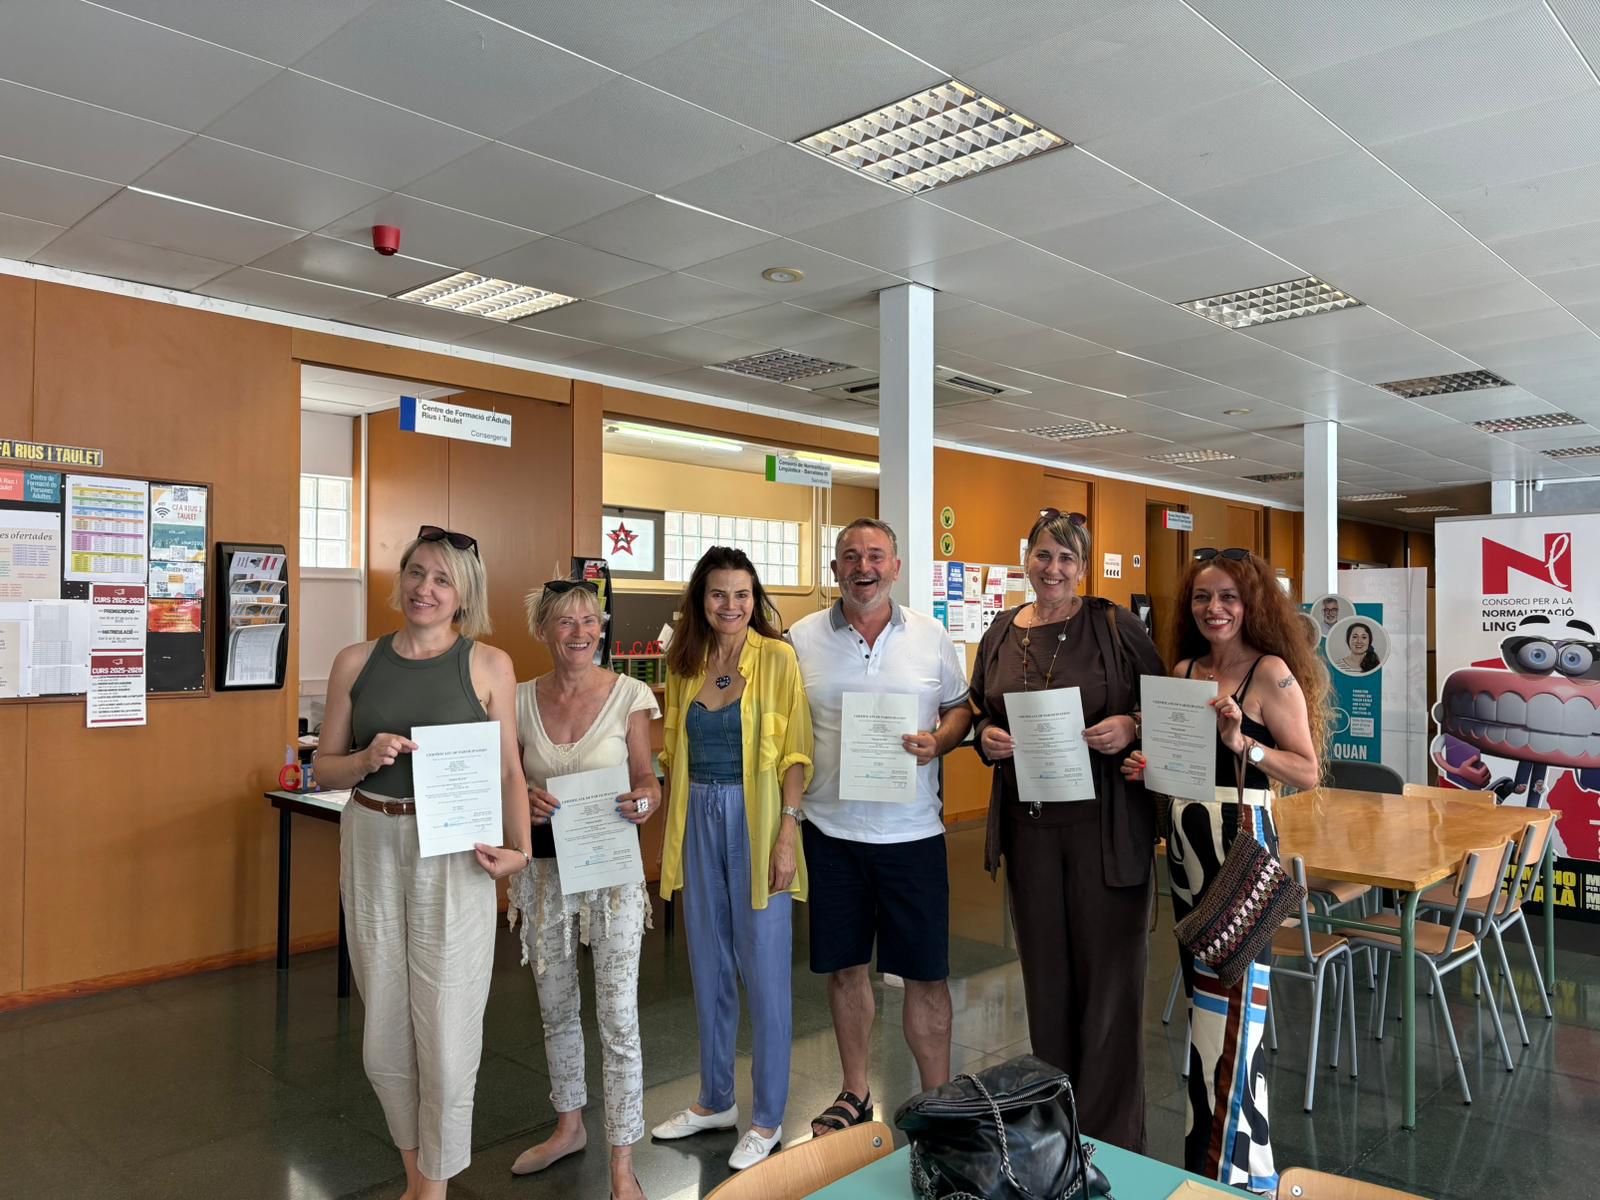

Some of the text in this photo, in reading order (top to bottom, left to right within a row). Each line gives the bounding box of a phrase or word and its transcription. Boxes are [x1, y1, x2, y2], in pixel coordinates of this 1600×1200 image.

[421, 412, 437, 421] Rius
[442, 415, 463, 425] Taulet
[422, 404, 511, 426] Centre de Formació d'Adults
[471, 430, 508, 442] Consergeria
[0, 441, 11, 458] A
[15, 443, 44, 460] RIUS
[56, 448, 100, 465] TAULET
[10, 531, 53, 541] ofertades
[1482, 598, 1530, 606] CONSORCI
[1561, 597, 1573, 605] LA
[1334, 743, 1367, 760] QUAN
